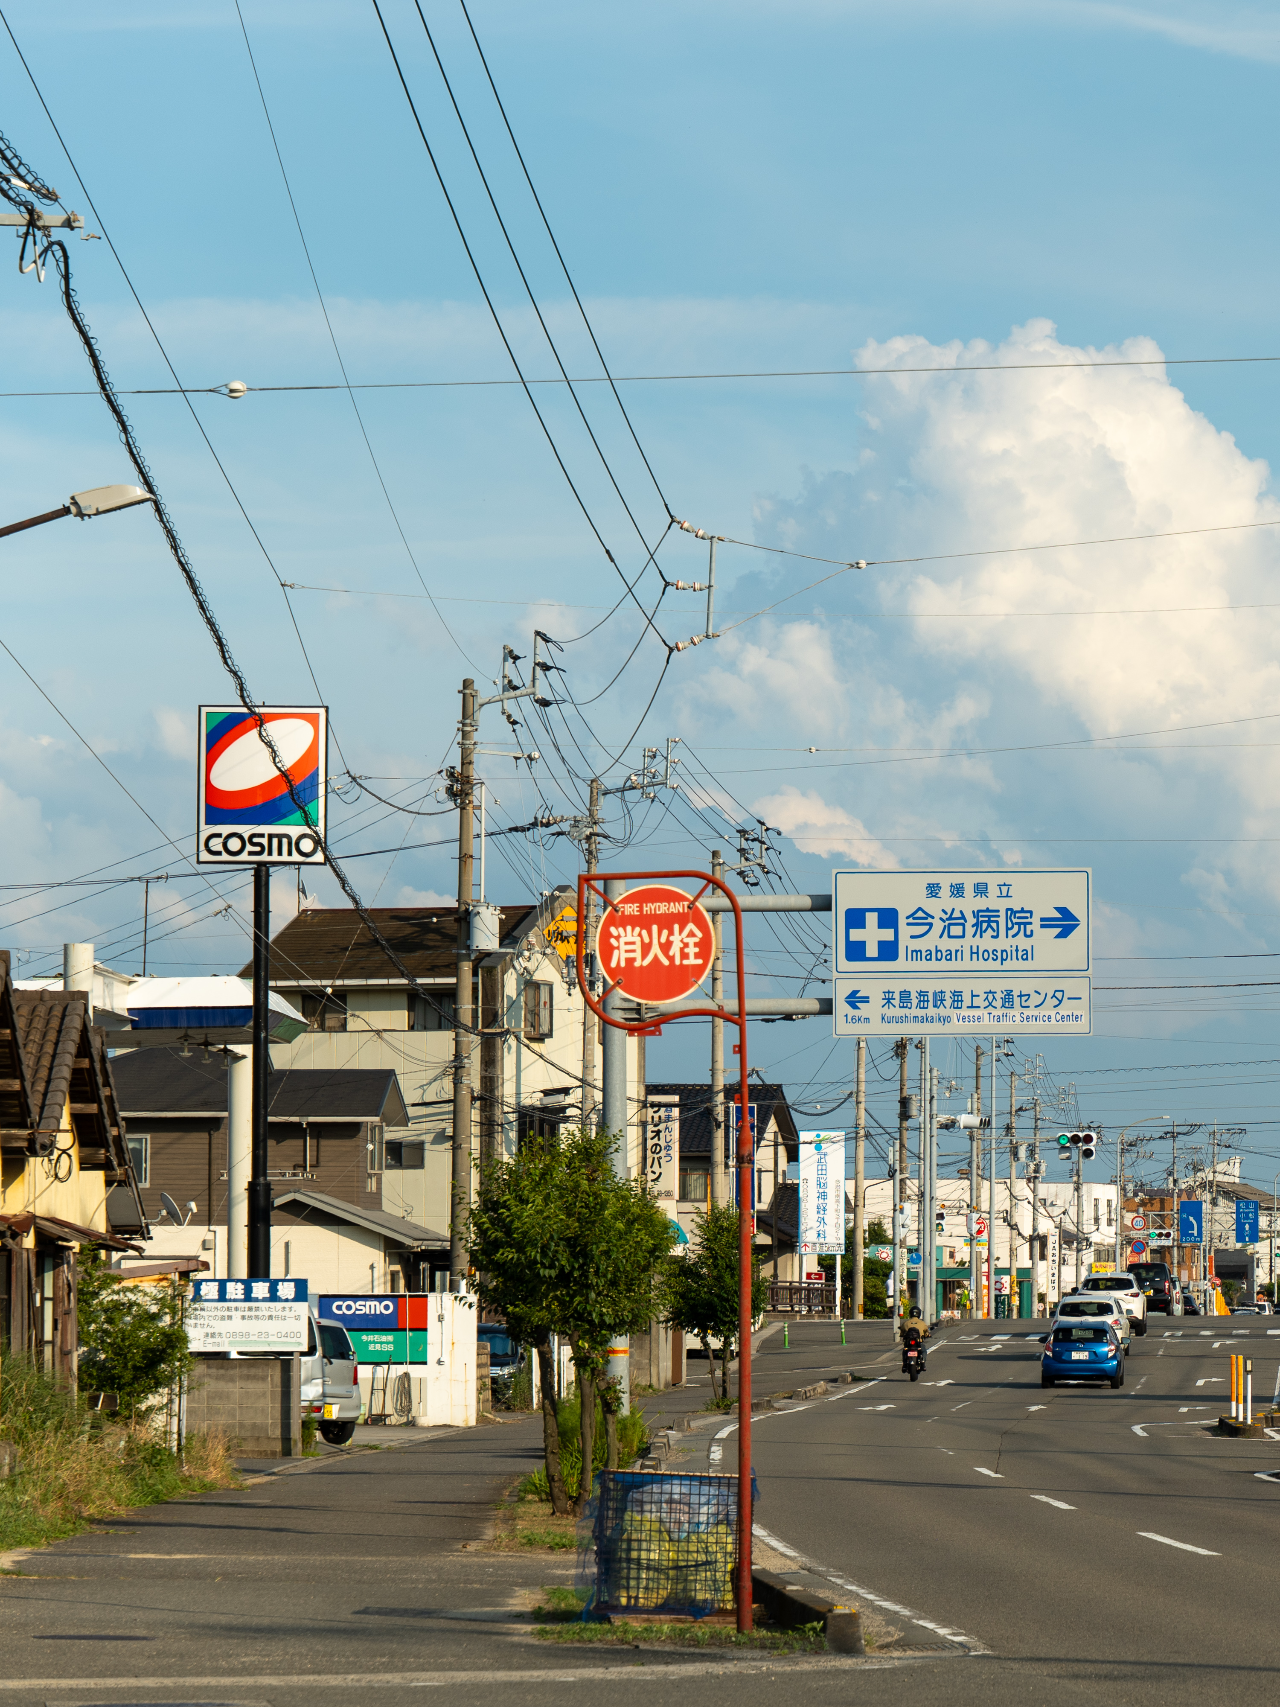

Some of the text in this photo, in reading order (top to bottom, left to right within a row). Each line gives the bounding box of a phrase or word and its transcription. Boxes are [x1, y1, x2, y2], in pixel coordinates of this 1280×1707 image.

[203, 831, 320, 857] COSMO
[925, 882, 1013, 899] 愛媛県立
[618, 901, 689, 915] FIRE HYDRANT
[905, 906, 1034, 939] 今治病院
[609, 922, 703, 968] 消火栓
[905, 944, 1034, 966] Imabari Hospital
[881, 989, 1083, 1010] 来島海峡海上交通センター
[843, 1013, 870, 1024] 1.6Km
[881, 1012, 1083, 1026] Kurushimakaikyo Vessel Traffic Service Center
[816, 1151, 828, 1242] 武田脳神経外科
[332, 1300, 394, 1314] COSMO
[225, 1331, 302, 1339] 0898-23-0400
[368, 1343, 394, 1351] 近見SS
